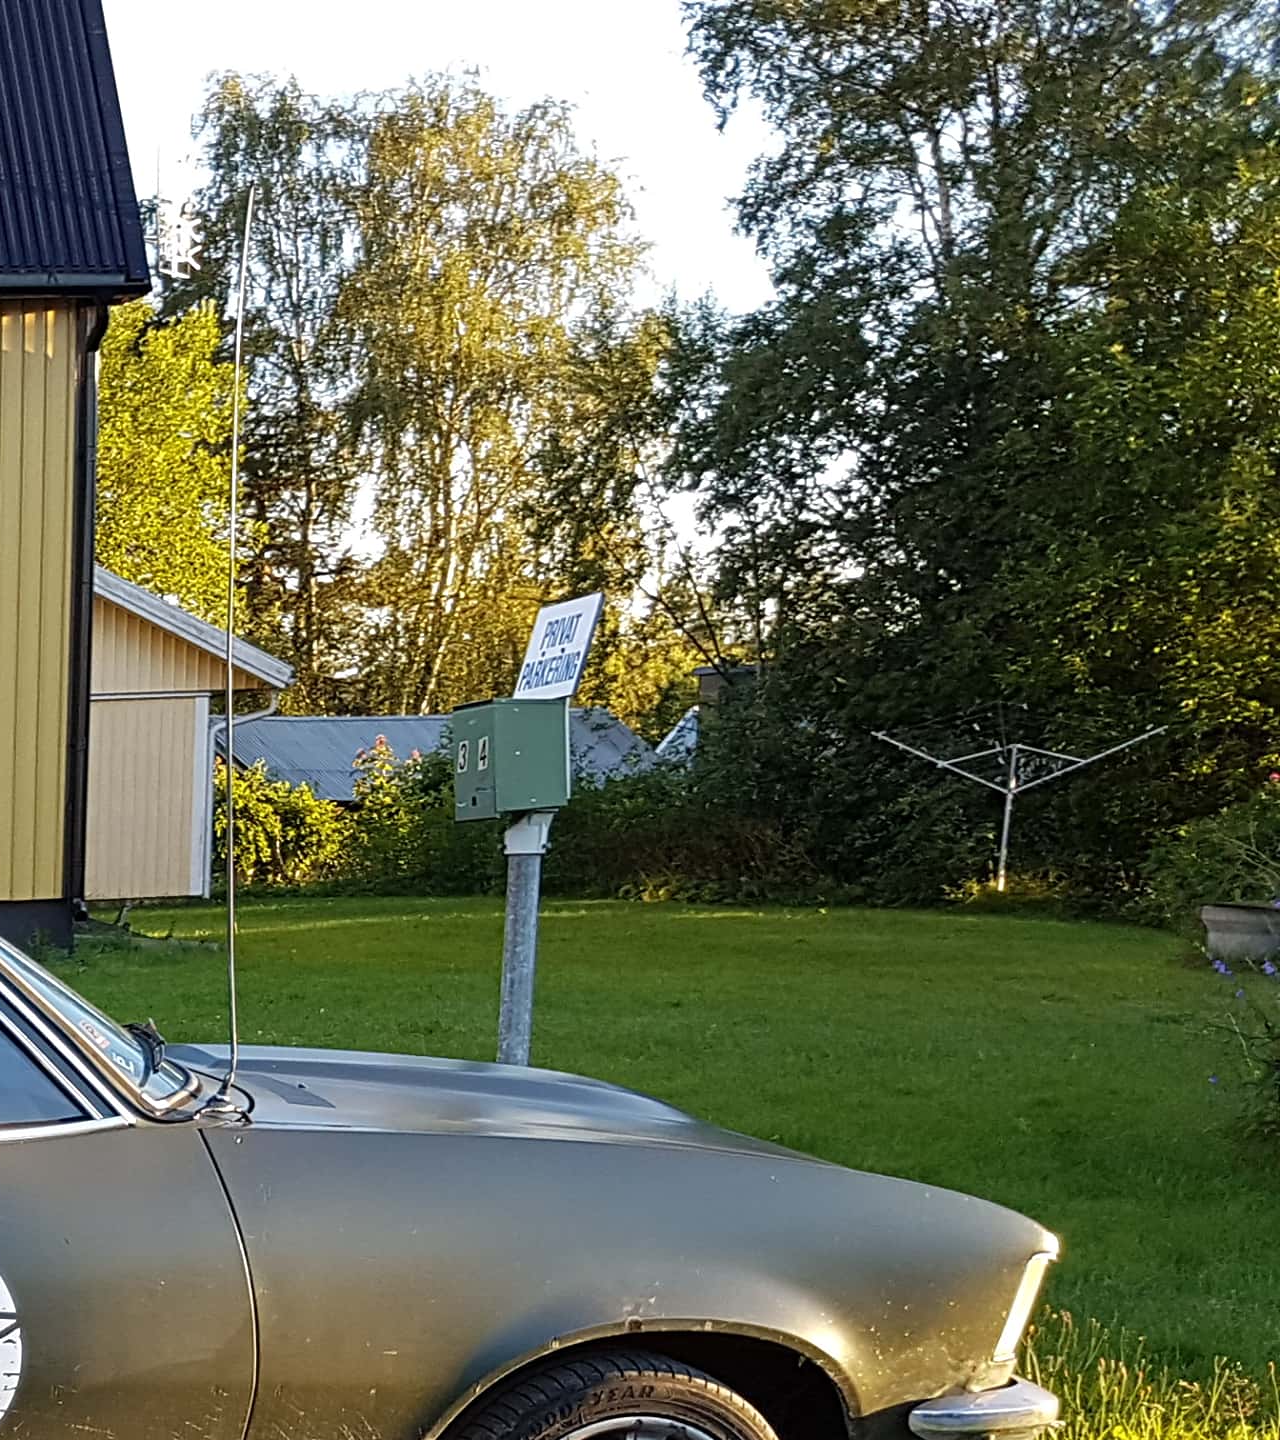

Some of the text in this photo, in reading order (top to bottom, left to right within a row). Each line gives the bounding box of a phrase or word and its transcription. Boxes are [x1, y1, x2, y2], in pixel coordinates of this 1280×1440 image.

[541, 613, 582, 650] PRIVAT
[519, 652, 580, 691] PARKERING
[458, 738, 488, 770] 3 4
